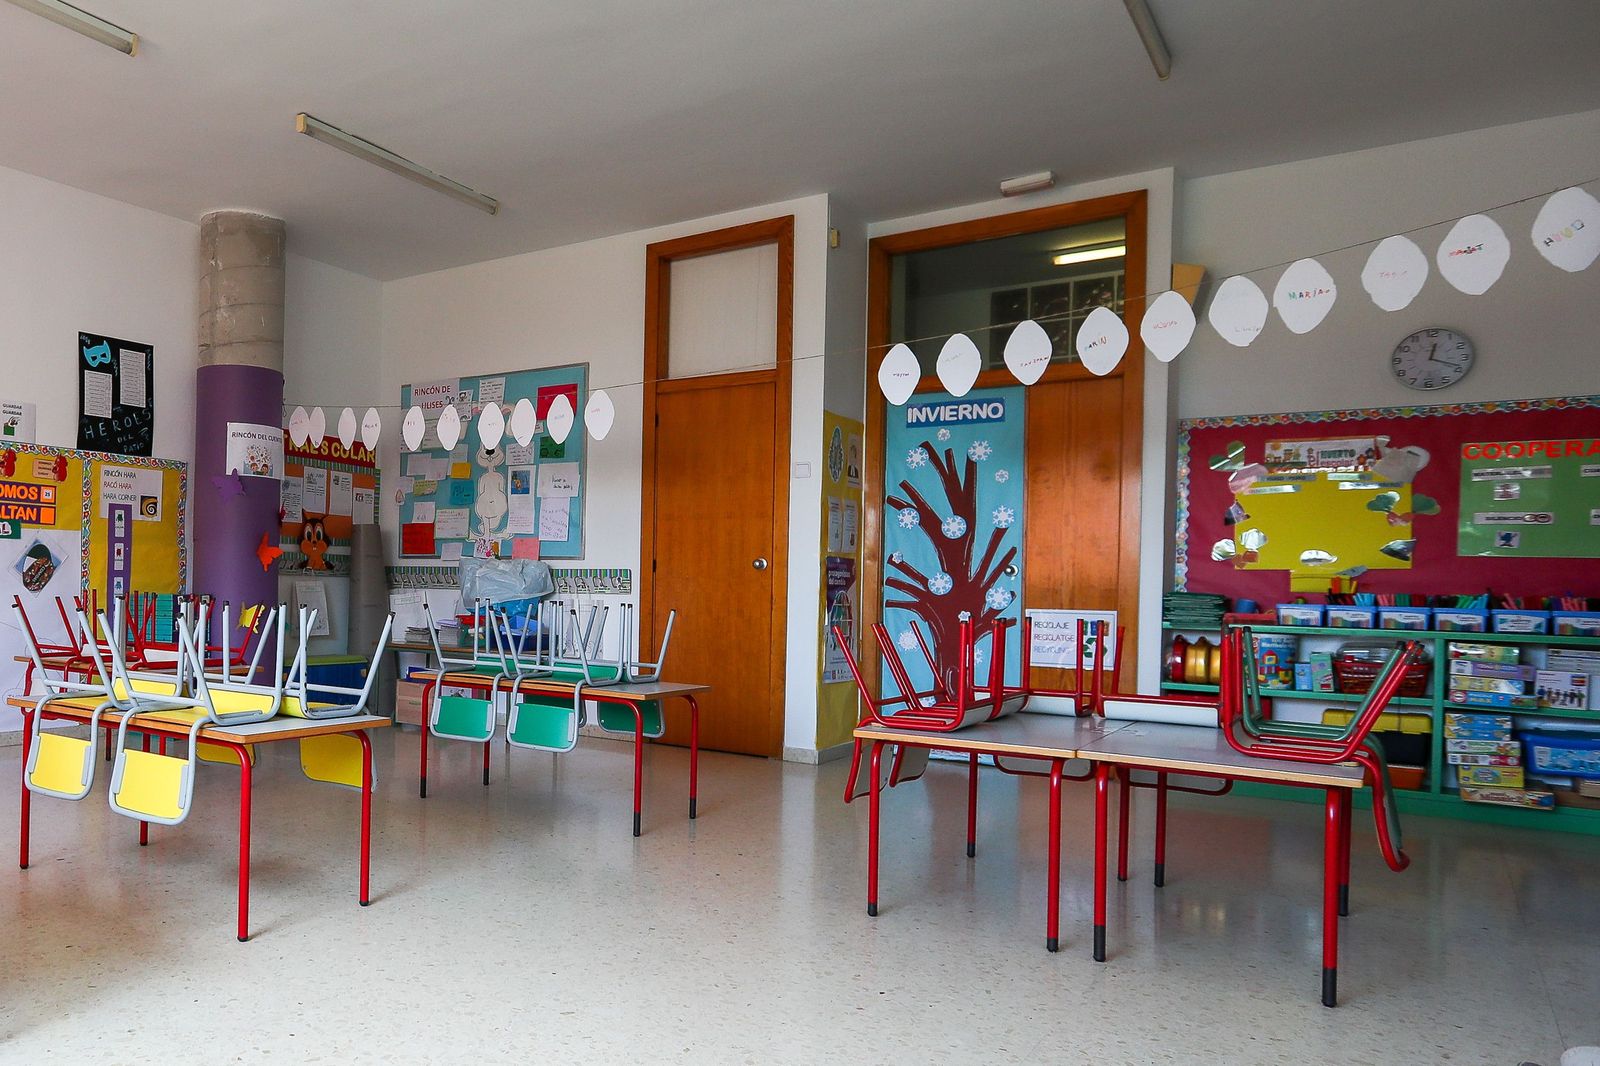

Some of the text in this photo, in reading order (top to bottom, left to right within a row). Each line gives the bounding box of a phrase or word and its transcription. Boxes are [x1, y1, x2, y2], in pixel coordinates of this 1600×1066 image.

[1399, 345, 1410, 353] 10
[1393, 357, 1402, 365] 9
[1461, 353, 1468, 361] 3
[1397, 369, 1406, 377] 8
[1424, 380, 1433, 388] 6
[1441, 376, 1450, 384] 5
[414, 385, 440, 396] RINCÓN
[907, 402, 1004, 424] INVIERNO
[231, 431, 257, 440] RINCÓN
[1462, 441, 1600, 460] COOPERA
[103, 469, 137, 479] RINCÓN HARA
[103, 481, 132, 490] RACÓ HARA
[117, 494, 137, 502] CORNER
[0, 505, 37, 521] LTAN
[1033, 621, 1070, 630] RECICLAJE
[1033, 634, 1076, 643] RECICLATGE
